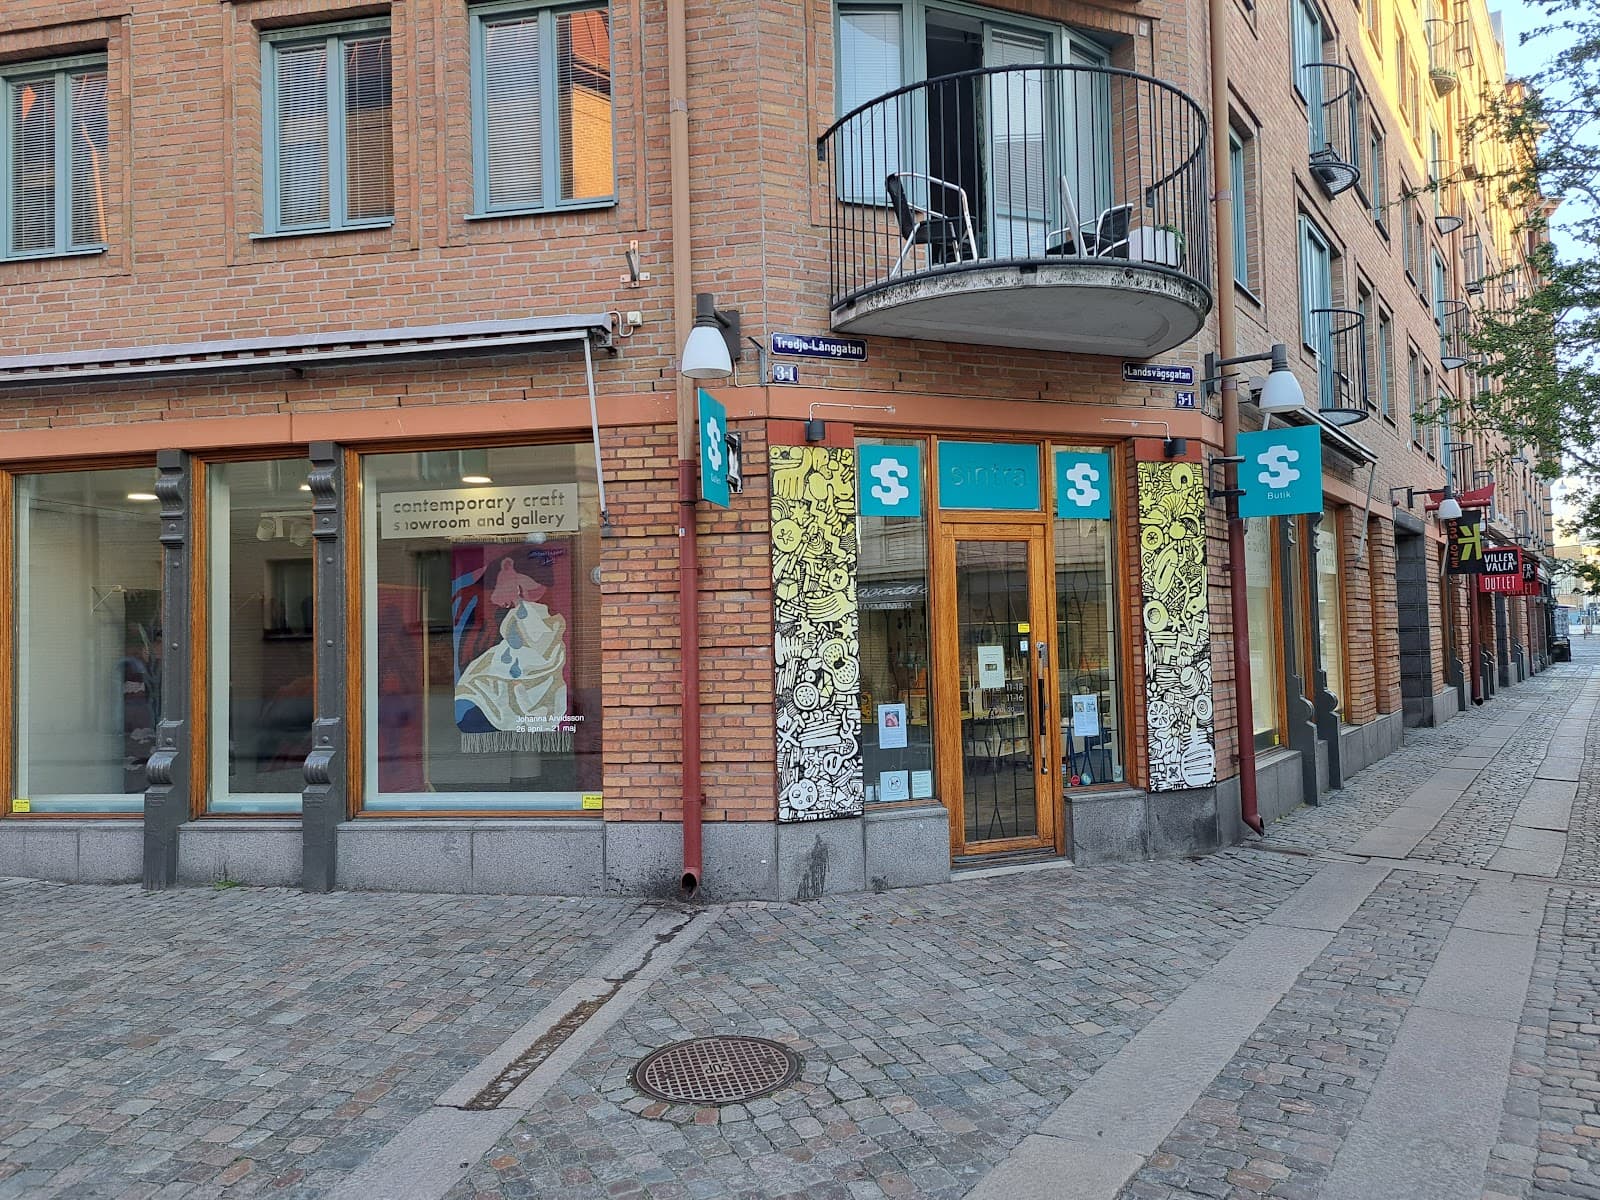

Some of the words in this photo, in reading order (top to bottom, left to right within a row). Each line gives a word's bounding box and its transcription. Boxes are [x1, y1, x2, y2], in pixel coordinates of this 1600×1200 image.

[776, 366, 795, 380] 3-1
[1127, 365, 1191, 381] Landsvägsgatan
[1178, 393, 1192, 406] 5-1
[1257, 445, 1300, 489] S
[870, 458, 909, 505] S
[951, 464, 1025, 487] sintra
[1066, 462, 1100, 507] S
[393, 496, 516, 515] contemporary
[523, 489, 566, 507] craft
[1267, 491, 1291, 499] Butik
[477, 512, 505, 528] and
[511, 510, 565, 529] gallery
[1484, 553, 1514, 563] VILLER
[1486, 562, 1514, 572] VALLA
[1484, 576, 1515, 590] OUTLET
[515, 715, 547, 723] Johanna
[549, 714, 585, 722] Arvidsson
[516, 725, 526, 733] 26
[527, 725, 543, 734] april
[562, 724, 577, 733] maj
